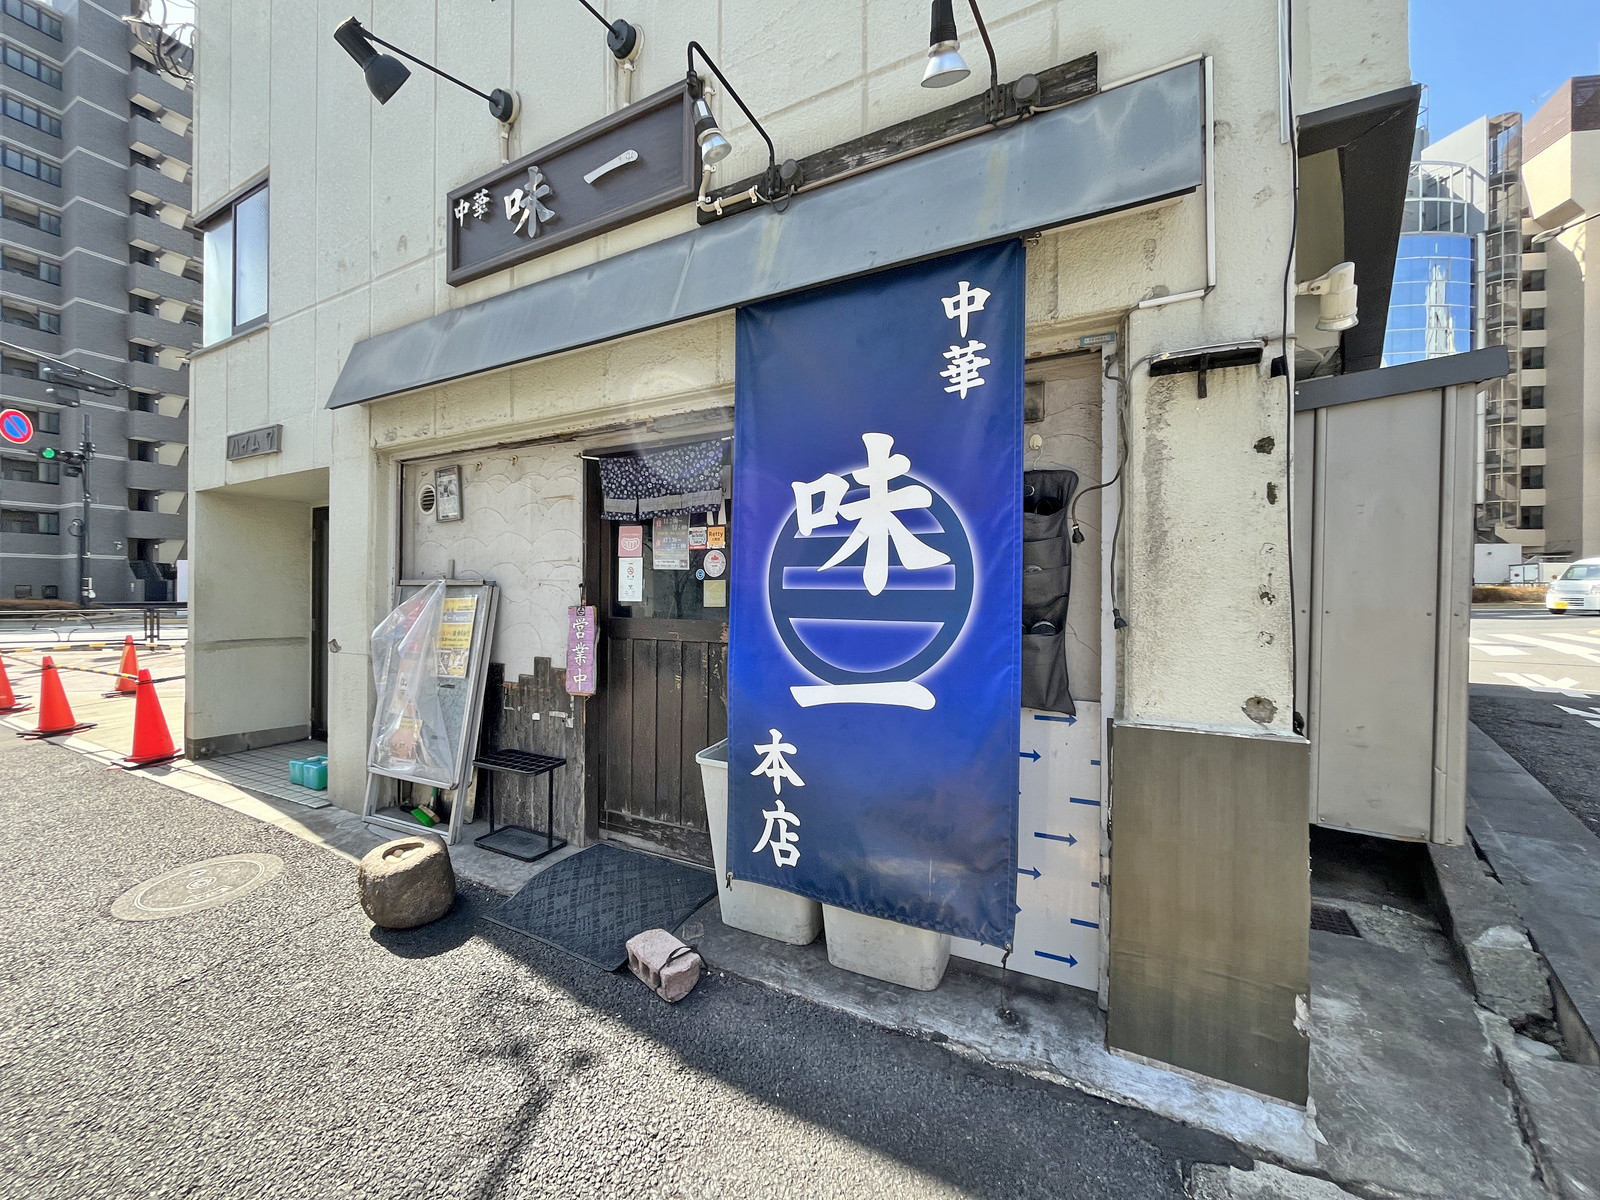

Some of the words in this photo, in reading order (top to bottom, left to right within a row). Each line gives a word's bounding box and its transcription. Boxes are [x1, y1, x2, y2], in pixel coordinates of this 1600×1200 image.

[454, 188, 490, 227] 中華
[504, 149, 639, 238] 味一
[939, 280, 991, 400] 中華
[572, 617, 590, 692] 営業中
[749, 728, 806, 868] 本店
